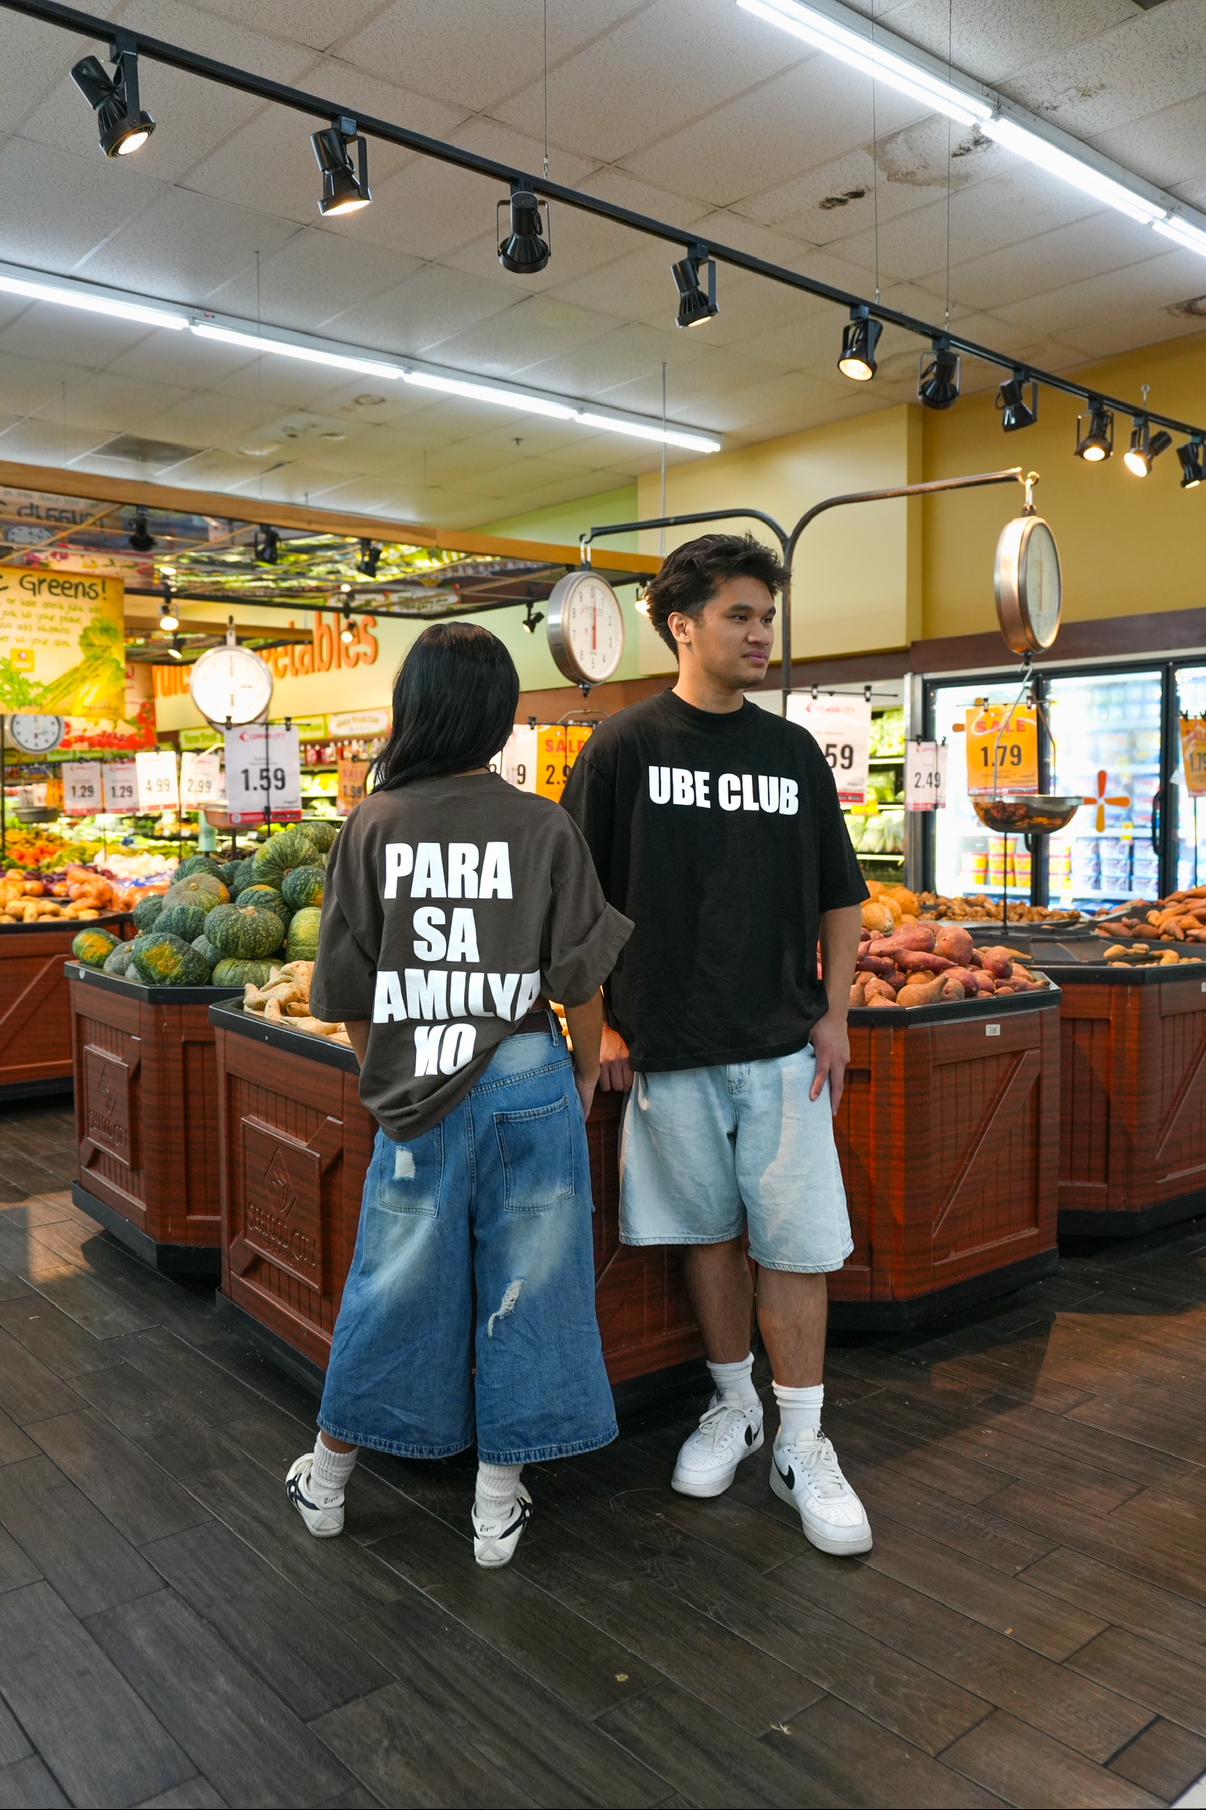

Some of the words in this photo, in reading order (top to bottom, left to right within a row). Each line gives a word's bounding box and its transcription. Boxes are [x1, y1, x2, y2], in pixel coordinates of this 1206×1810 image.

[19, 574, 106, 601] Greens!
[976, 720, 1026, 733] SALE
[825, 744, 854, 770] 59
[980, 744, 1022, 767] 1.79
[241, 768, 286, 791] 1.59
[546, 764, 572, 784] 2.9
[914, 772, 941, 788] 2.49
[72, 785, 94, 798] 1.29
[111, 786, 132, 798] 1.29
[146, 778, 170, 792] 4.99
[188, 779, 211, 794] 2.99
[648, 766, 711, 808] UBE
[718, 773, 798, 816] CLUB
[384, 842, 513, 899] PARA
[413, 906, 480, 962] SA
